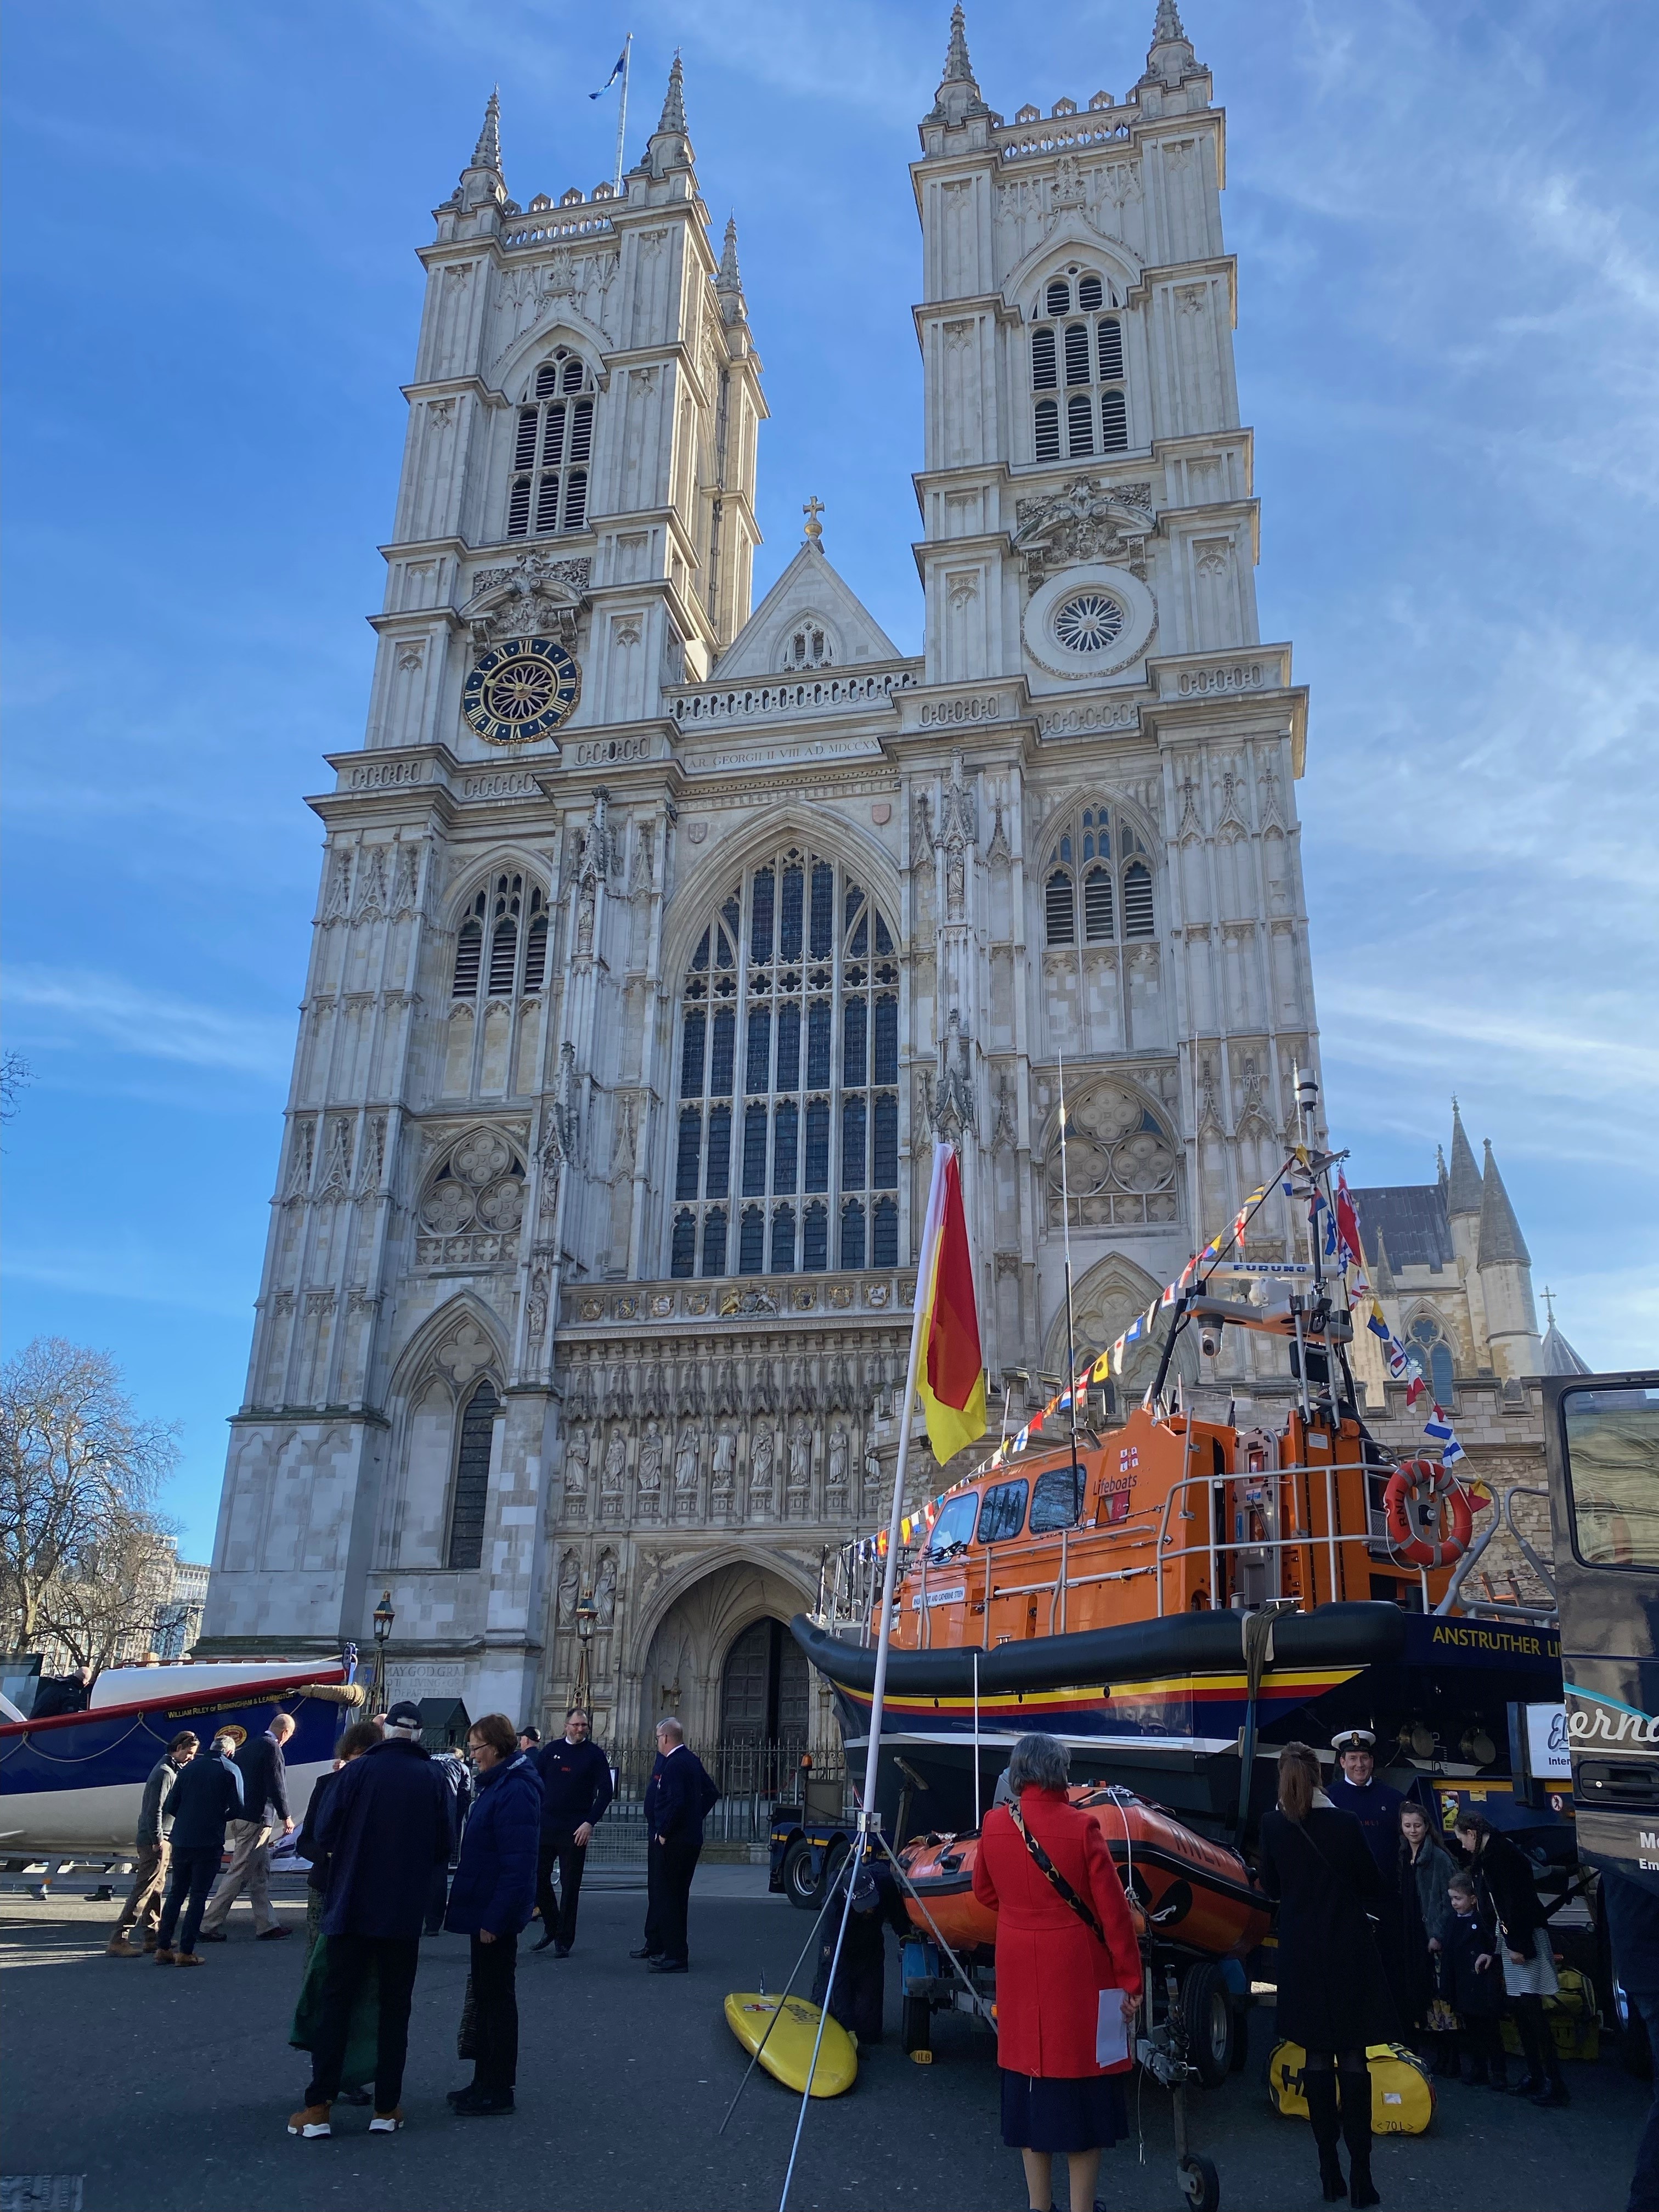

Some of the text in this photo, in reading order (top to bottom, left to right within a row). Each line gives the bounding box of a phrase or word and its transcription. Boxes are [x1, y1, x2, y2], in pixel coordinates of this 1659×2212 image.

[828, 740, 880, 753] MDCCXX
[1093, 1474, 1138, 1496] Lifeboats
[1395, 1489, 1407, 1527] RNLI
[1432, 1626, 1541, 1656] ANSTRUTHER
[408, 1666, 435, 1677] GOD
[445, 1689, 463, 1697] RES
[168, 1709, 193, 1718] WILLIAM
[193, 1706, 209, 1715] RILEY
[217, 1699, 252, 1711] BIRMINGHAM
[1165, 1820, 1221, 1867] RNLI
[1640, 1832, 1659, 1849] M
[918, 2052, 930, 2062] ILB
